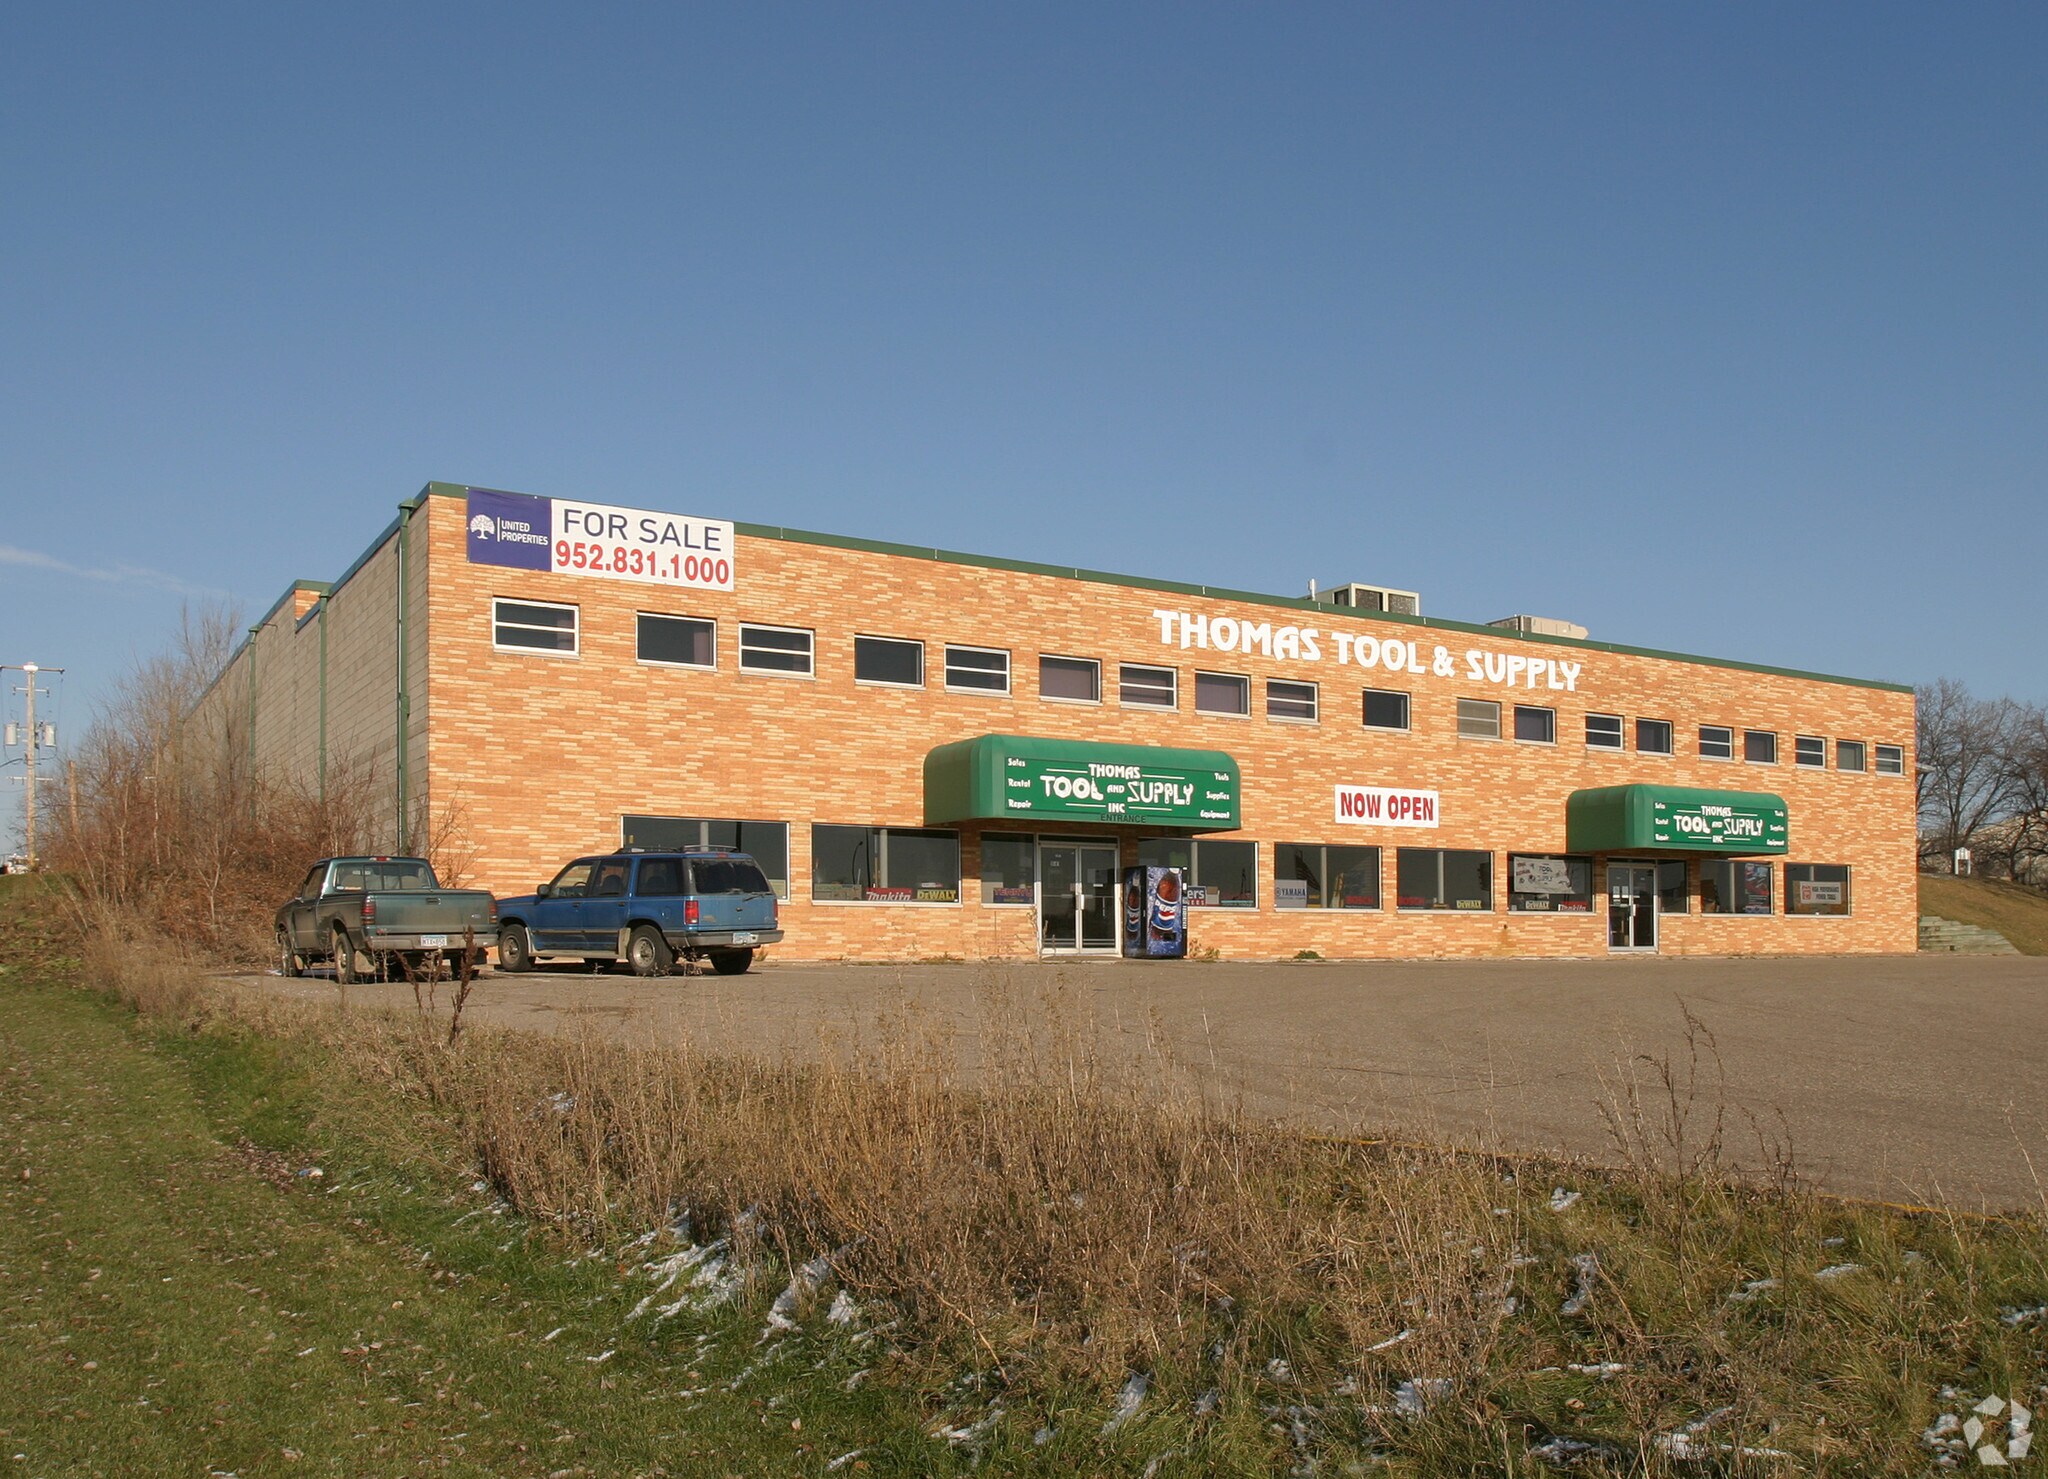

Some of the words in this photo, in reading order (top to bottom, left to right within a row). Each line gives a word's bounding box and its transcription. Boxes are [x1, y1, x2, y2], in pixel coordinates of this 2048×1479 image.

[501, 520, 530, 533] UNITED
[564, 508, 628, 540] FOR
[639, 518, 721, 551] SALE
[501, 532, 549, 546] PROPERTIES
[555, 540, 729, 584] 952.831.1000
[1153, 609, 1321, 661] THOMAS
[1331, 632, 1427, 674] TOOL
[1432, 645, 1456, 677] &
[1465, 649, 1582, 693] SUPPLY
[1008, 758, 1026, 767] Sales
[1089, 763, 1141, 779] THOMAS
[1008, 778, 1031, 788] Rental
[1040, 775, 1104, 801] TOOL
[1107, 784, 1125, 794] AND
[1127, 780, 1194, 805] SUPPLY
[1008, 799, 1032, 810] Repair
[1108, 803, 1125, 814] INC
[1341, 792, 1381, 818] NOW
[1388, 795, 1434, 821] OPEN
[1701, 806, 1732, 818] THOMAS
[1101, 814, 1146, 824] ENTRANCE
[1673, 815, 1711, 834] TOOL
[1723, 818, 1763, 836] SUPPLY
[1281, 887, 1308, 897] YAMAHA
